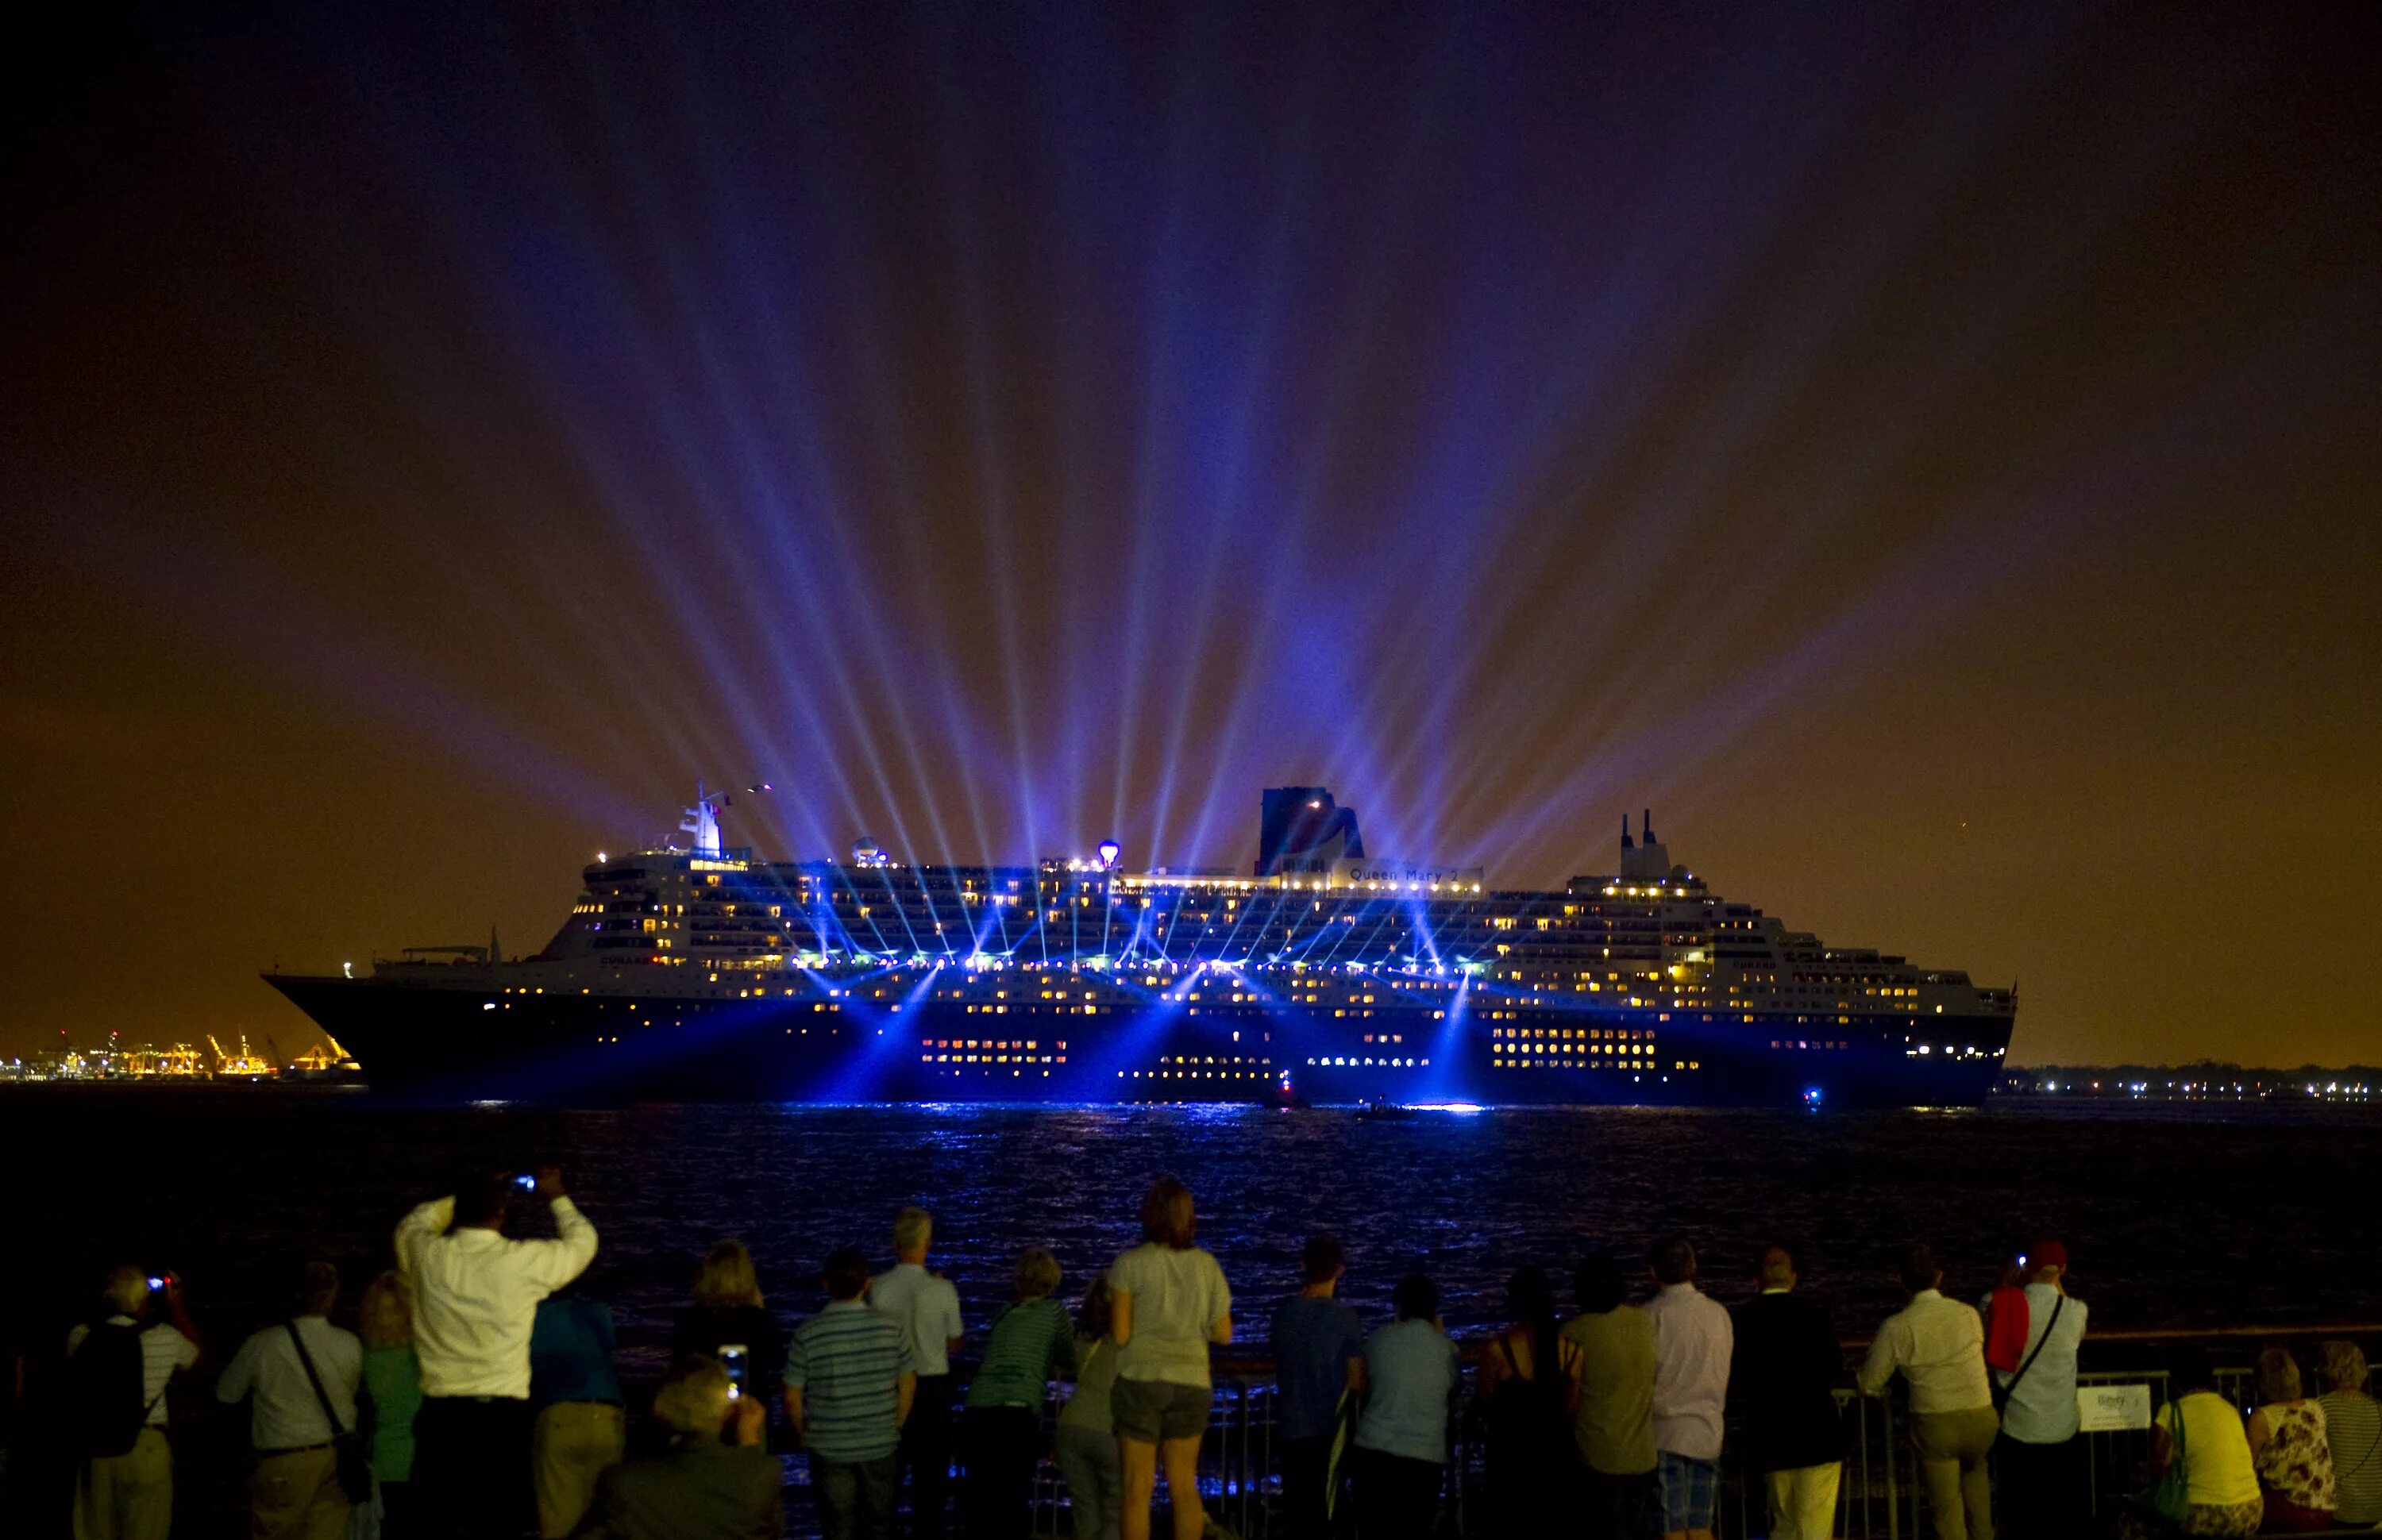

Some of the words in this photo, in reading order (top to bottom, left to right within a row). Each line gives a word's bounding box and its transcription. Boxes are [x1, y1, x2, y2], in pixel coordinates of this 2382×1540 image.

[1350, 868, 1397, 881] Queen
[1406, 870, 1442, 884] Mary
[1451, 870, 1459, 881] 2
